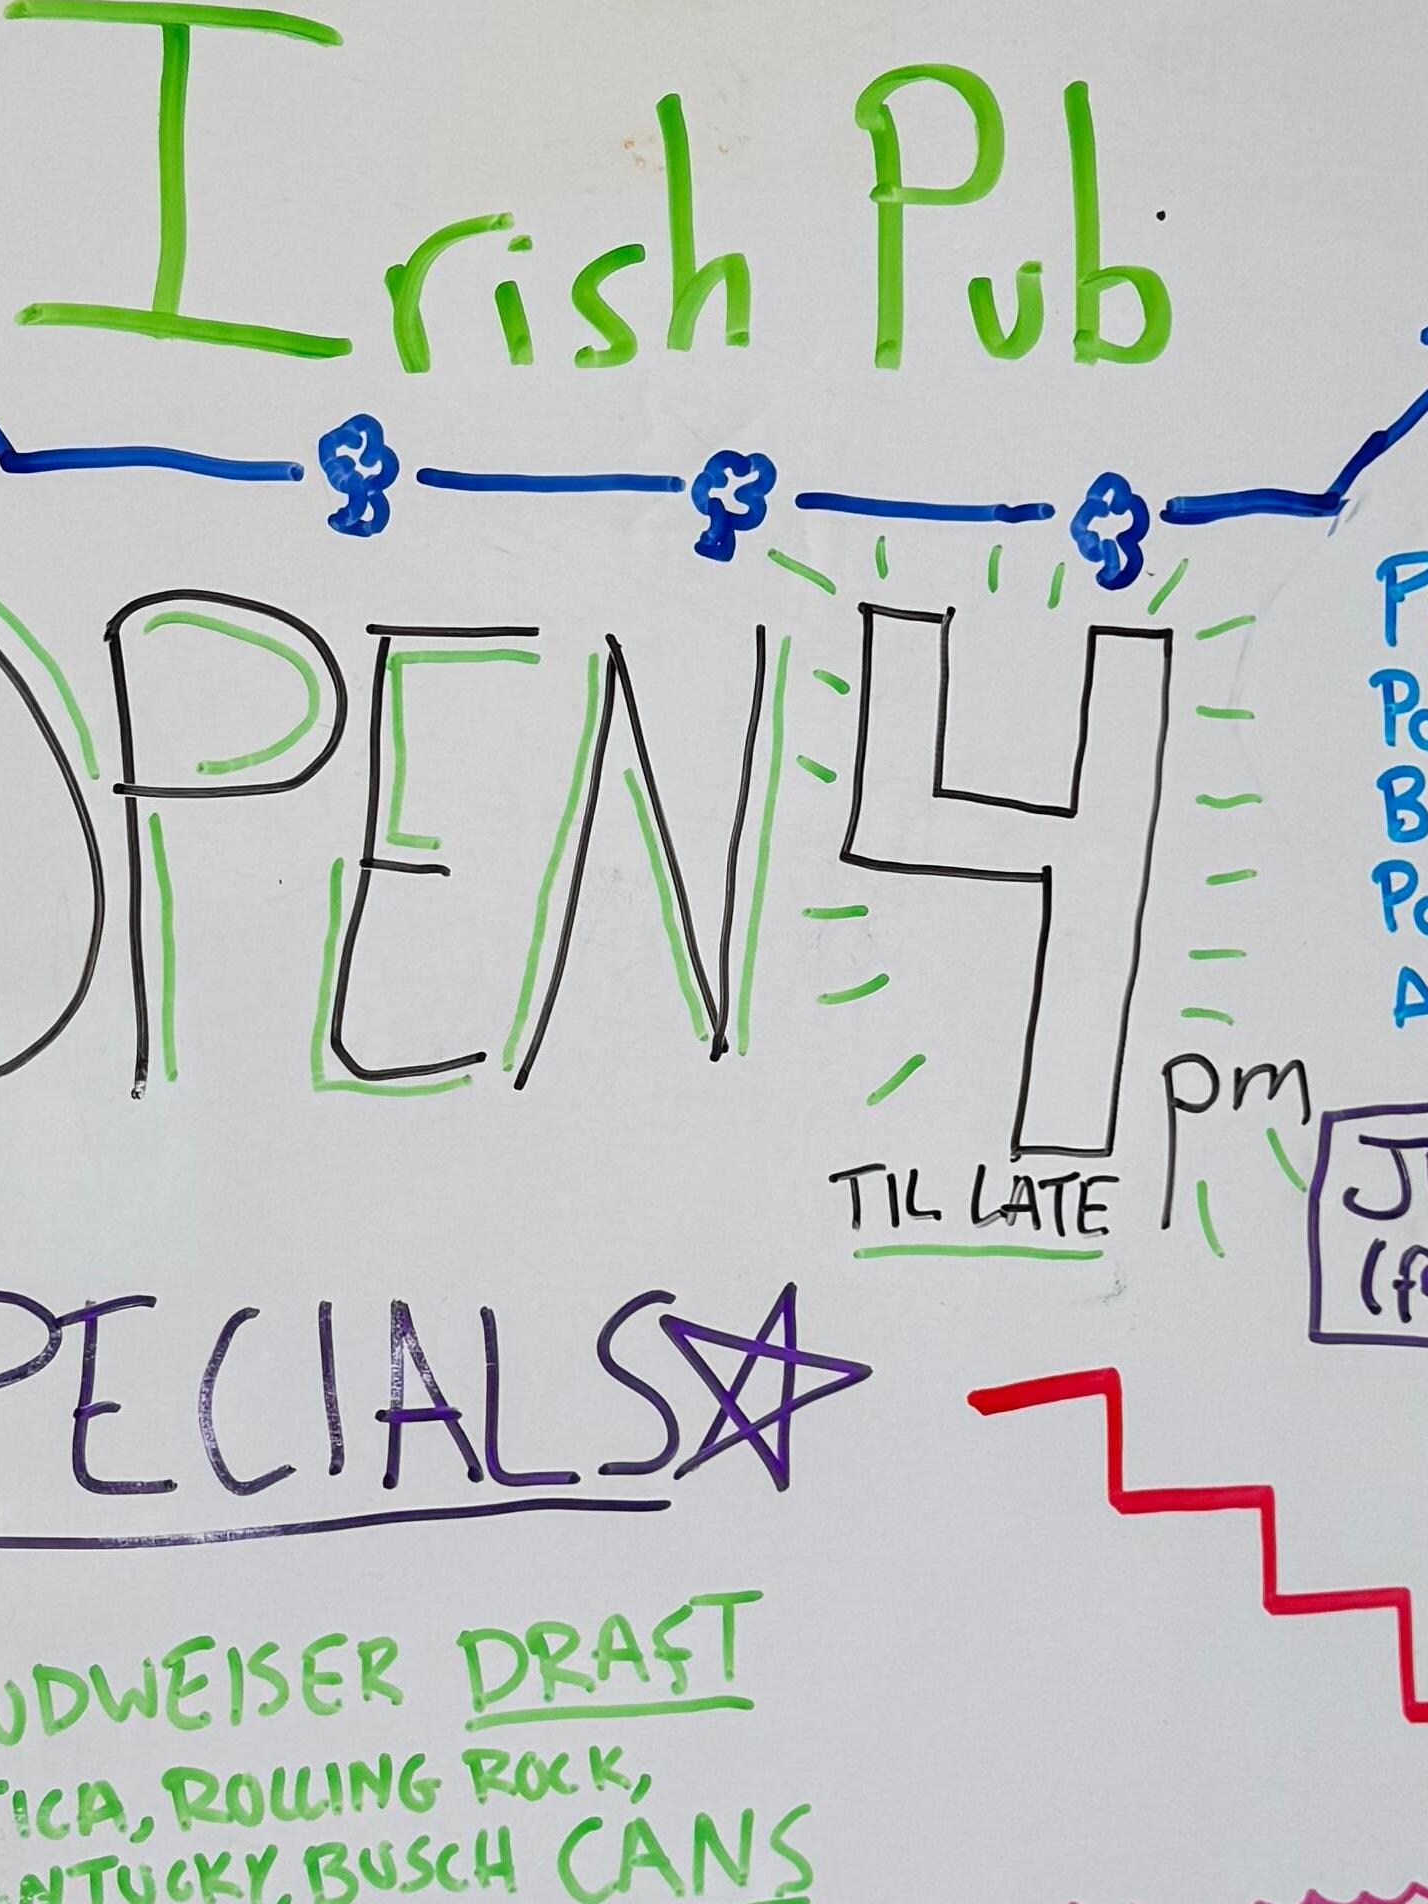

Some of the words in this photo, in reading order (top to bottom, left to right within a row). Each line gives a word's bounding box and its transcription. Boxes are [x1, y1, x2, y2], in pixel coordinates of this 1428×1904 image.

[852, 62, 1173, 371] Pub
[827, 1162, 943, 1230] TIL
[969, 1168, 1121, 1238] LATE
[457, 1589, 764, 1702] DRAFT
[159, 1752, 442, 1833] ROLLING
[460, 1744, 653, 1806] ROCK,
[556, 1802, 814, 1900] CANS
